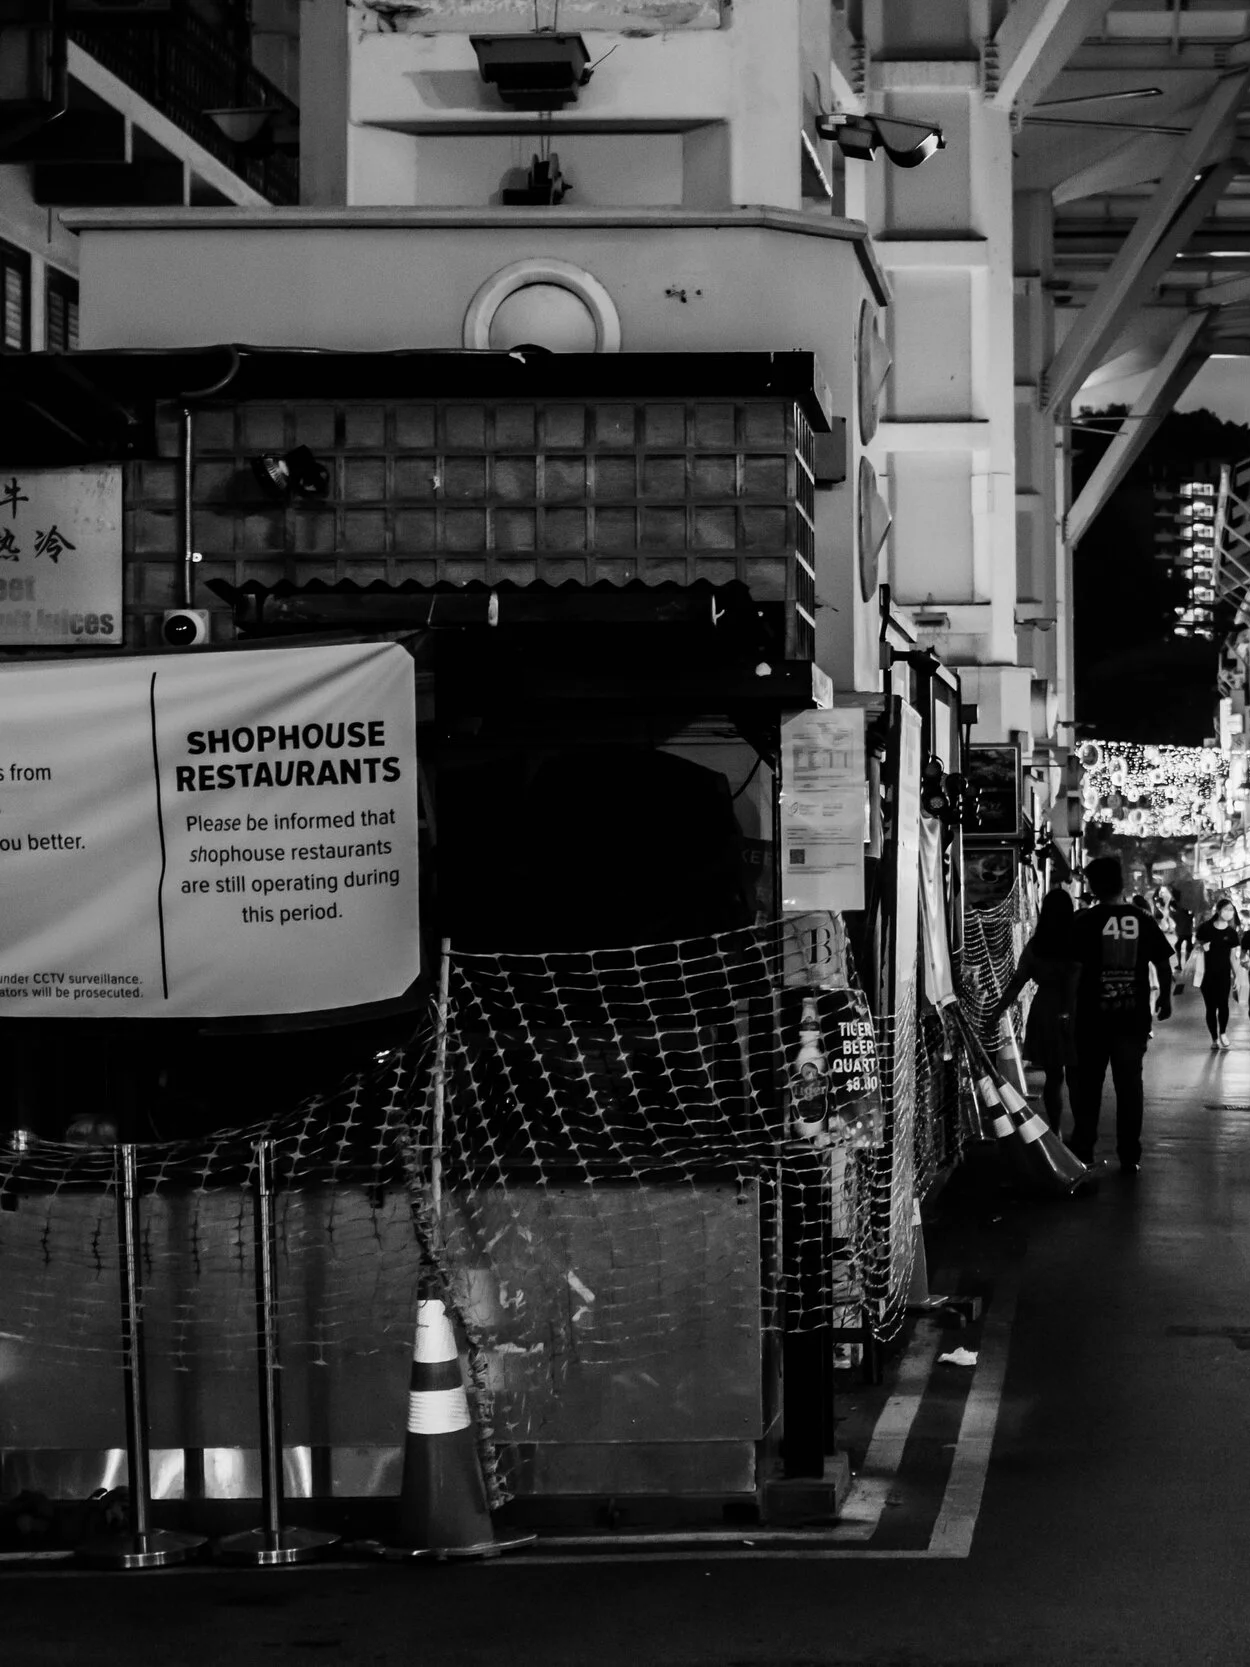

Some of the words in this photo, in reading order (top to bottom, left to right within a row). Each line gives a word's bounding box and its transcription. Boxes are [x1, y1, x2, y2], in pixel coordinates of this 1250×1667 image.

[187, 721, 385, 755] SHOPHOUSE
[10, 763, 52, 781] from
[176, 756, 401, 792] RESTAURANTS
[186, 815, 241, 833] Please
[246, 813, 268, 831] be
[274, 810, 355, 830] informed
[361, 808, 396, 828] that
[28, 833, 86, 850] better.
[189, 843, 286, 867] shophouse
[291, 839, 393, 861] restaurants
[181, 879, 210, 894] are
[215, 876, 246, 893] still
[252, 873, 338, 896] operating
[343, 867, 401, 888] during
[242, 906, 274, 924] this
[280, 903, 344, 926] period.
[1102, 915, 1140, 940] 49
[33, 973, 65, 984] CCTV
[69, 974, 143, 985] surveillance.
[32, 987, 52, 998] will
[56, 987, 70, 998] be
[74, 987, 144, 1000] prosecuted.
[837, 1021, 872, 1037] TIGER
[842, 1040, 875, 1055] BEER
[832, 1058, 876, 1073] QUART
